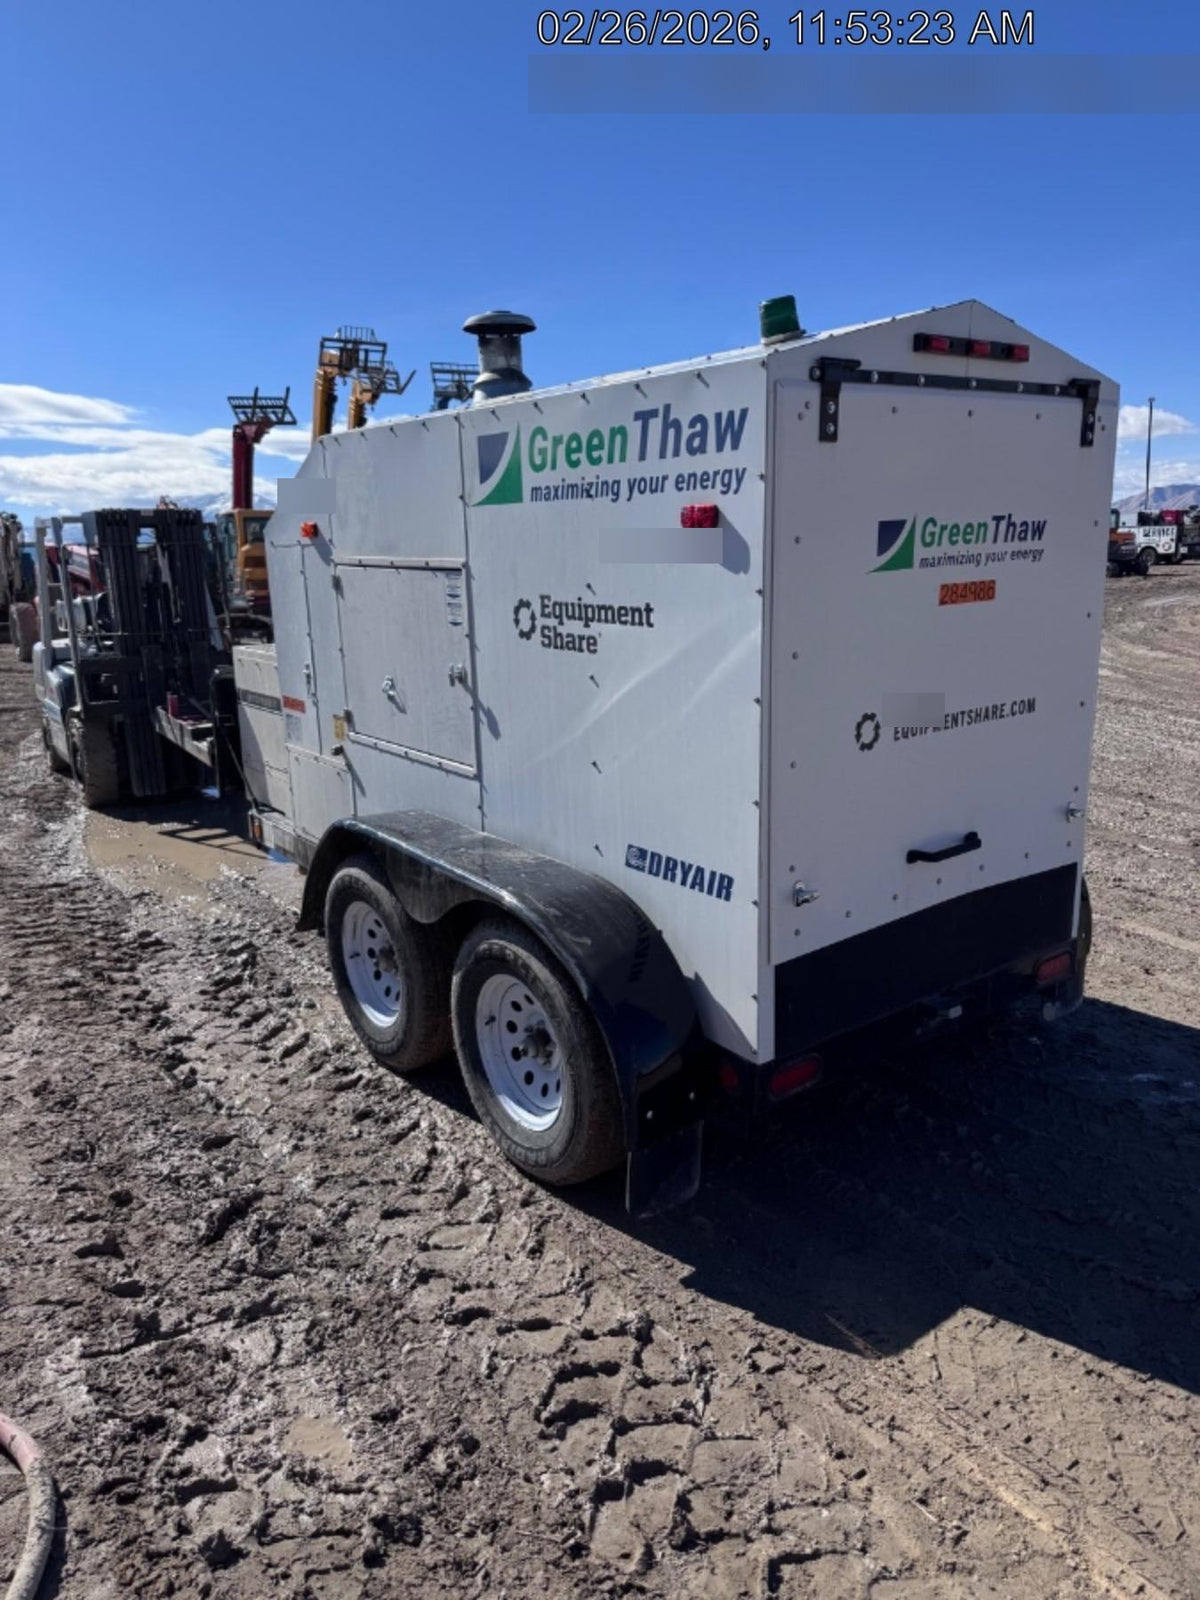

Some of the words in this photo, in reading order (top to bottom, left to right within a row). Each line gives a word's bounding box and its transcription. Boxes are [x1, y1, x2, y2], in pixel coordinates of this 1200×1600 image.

[530, 474, 621, 503] maximizing
[626, 473, 668, 502] your
[674, 467, 747, 495] energy
[919, 550, 982, 569] maximizing
[984, 549, 1008, 566] your
[1010, 548, 1045, 562] energy
[938, 580, 996, 606] 284986
[539, 594, 655, 628] Equipment
[540, 625, 598, 654] Share
[647, 850, 735, 902] DRYAIR
